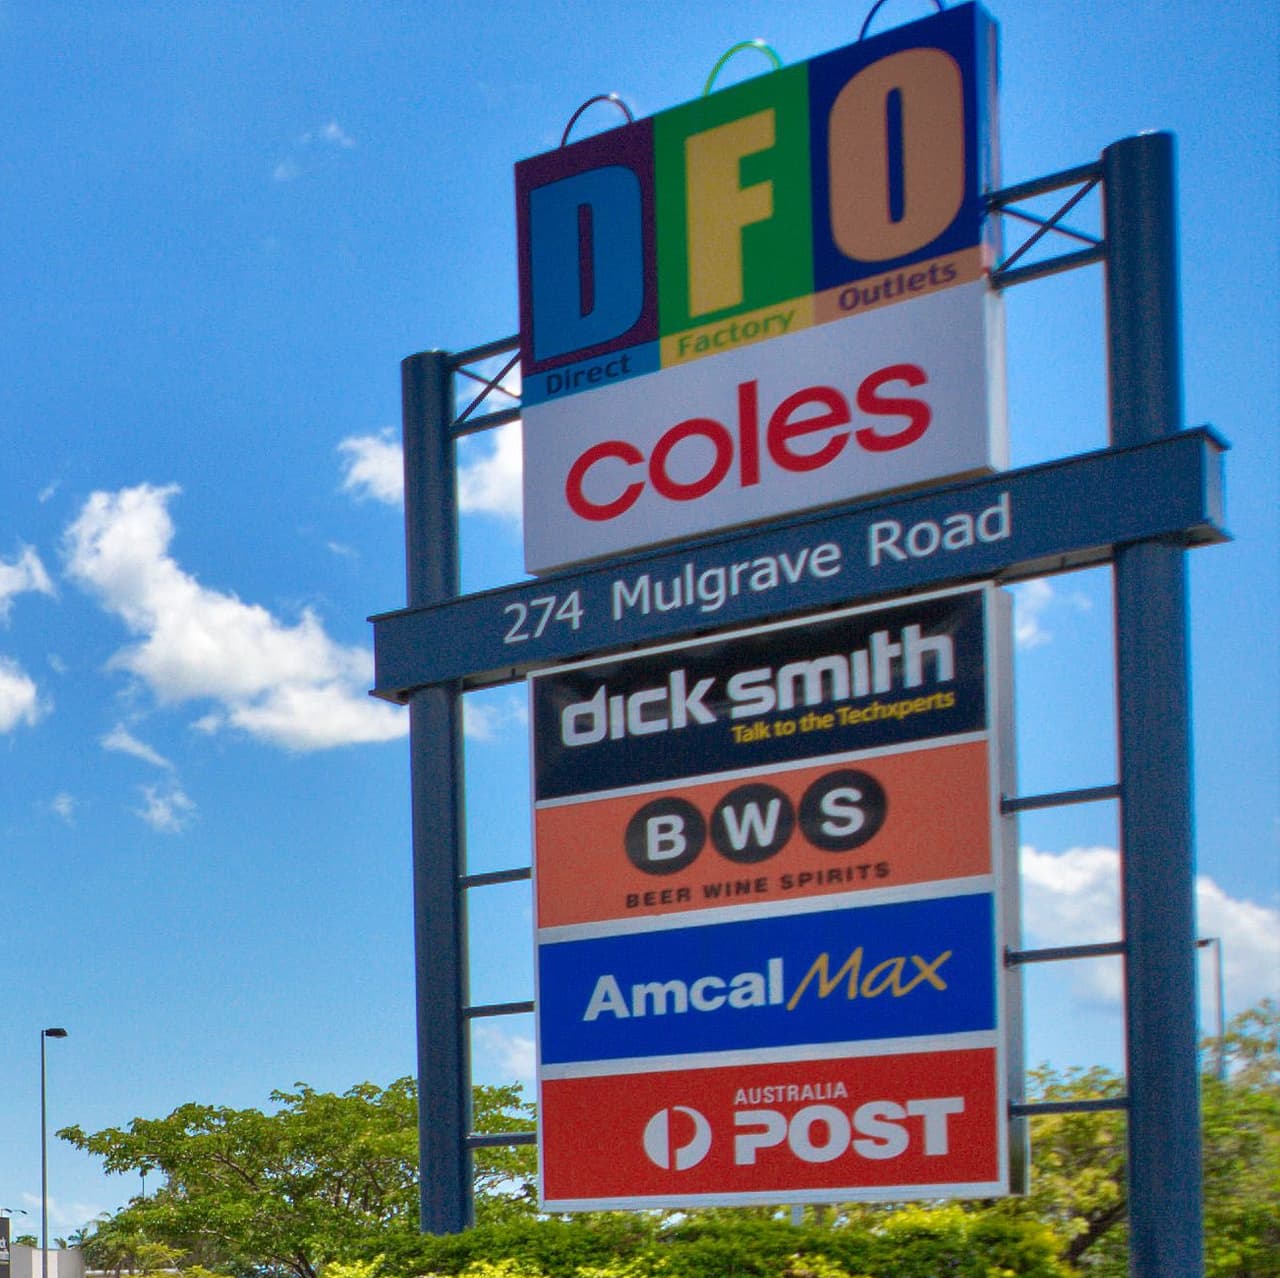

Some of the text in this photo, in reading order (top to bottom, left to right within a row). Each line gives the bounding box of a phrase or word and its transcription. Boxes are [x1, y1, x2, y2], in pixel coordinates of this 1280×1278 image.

[529, 47, 966, 362] DFO
[546, 261, 957, 396] Direct Factory Outlets
[565, 363, 933, 522] coles
[502, 491, 1012, 645] 274 Mulgrave Road
[561, 624, 955, 747] dick smith
[731, 691, 956, 744] Talk to the Techxperts
[646, 787, 866, 862] BWS
[626, 861, 891, 909] BEER WINE SPIRITS
[582, 946, 952, 1022] Amcal Max
[734, 1081, 849, 1106] AUSTRALIA
[734, 1096, 965, 1165] POST
